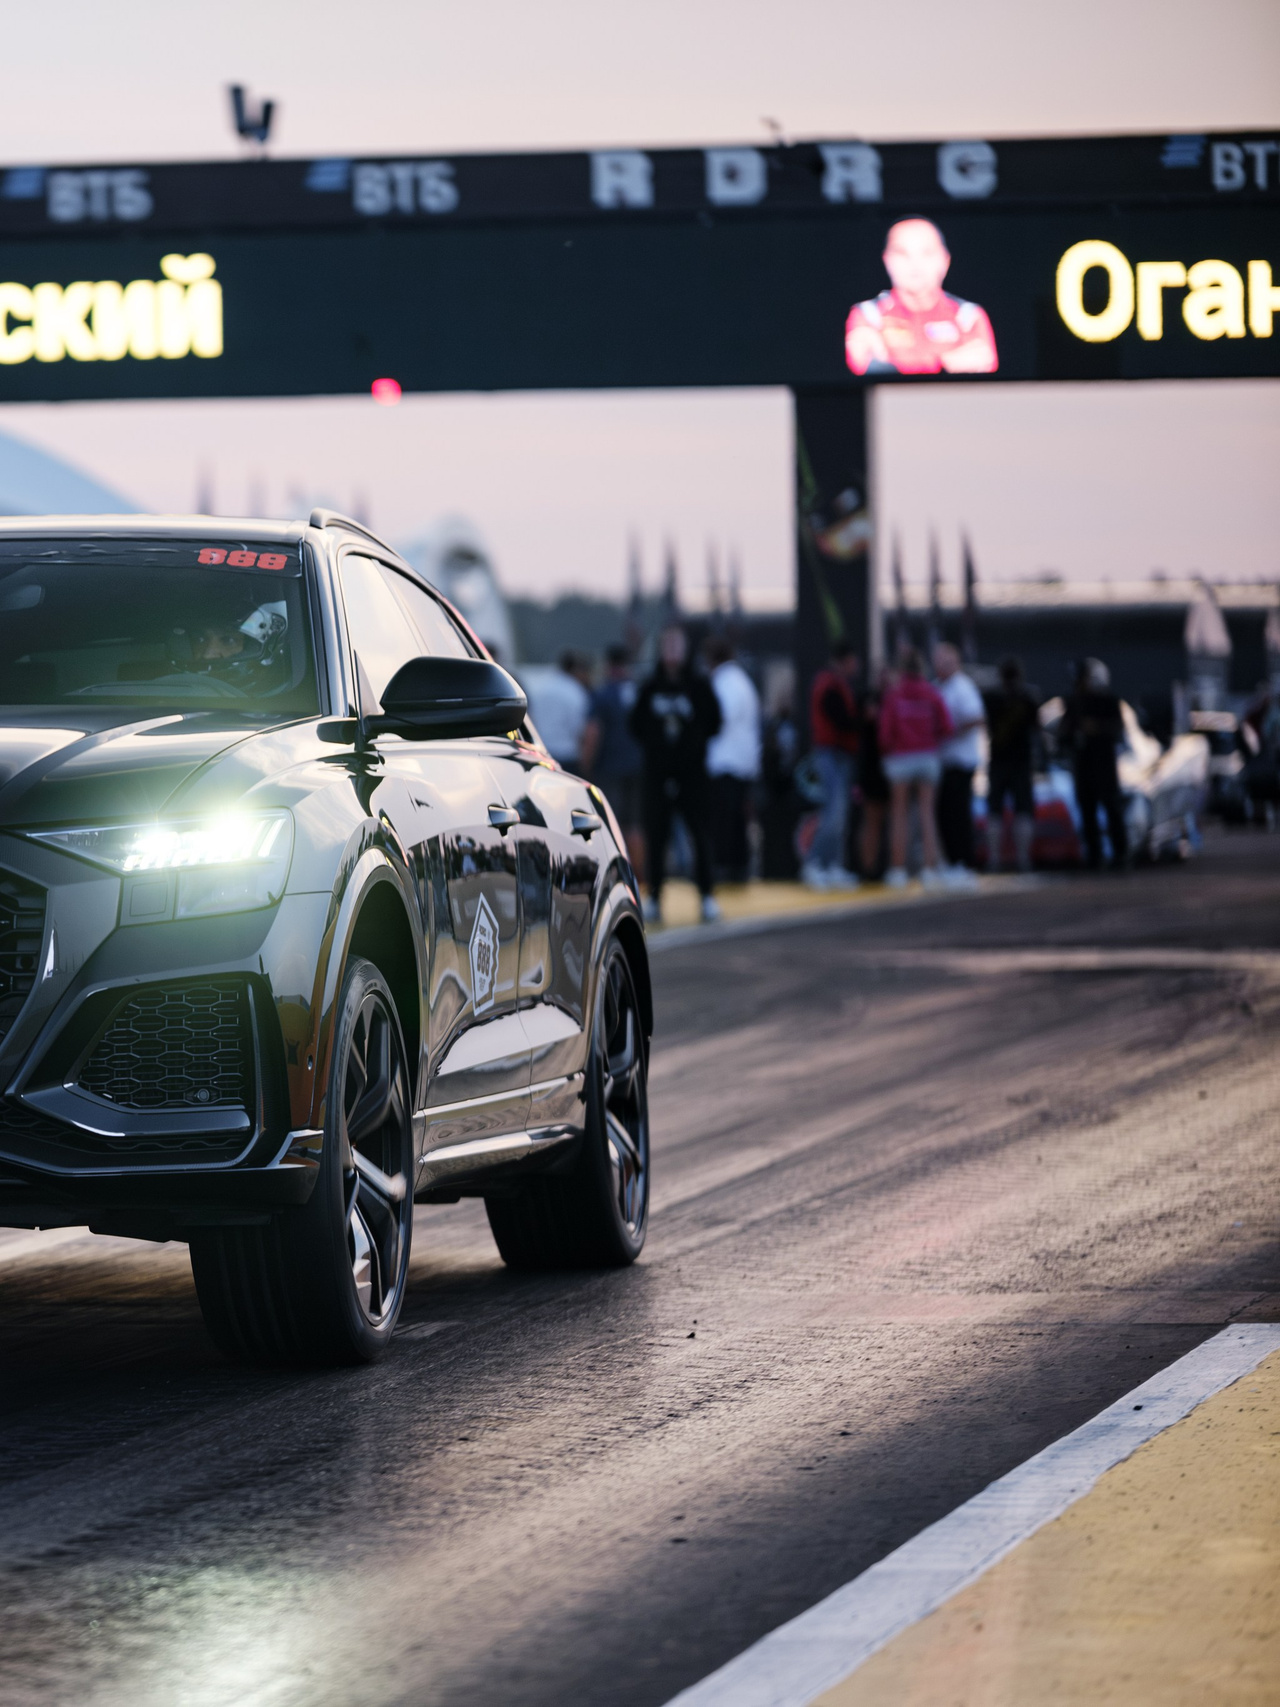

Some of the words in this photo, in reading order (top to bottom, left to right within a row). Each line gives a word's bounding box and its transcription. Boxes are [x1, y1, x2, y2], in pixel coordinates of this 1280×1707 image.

[354, 162, 460, 215] ВТБ
[1212, 141, 1280, 191] ВТ
[47, 170, 152, 222] ВТБ
[197, 547, 288, 571] 888
